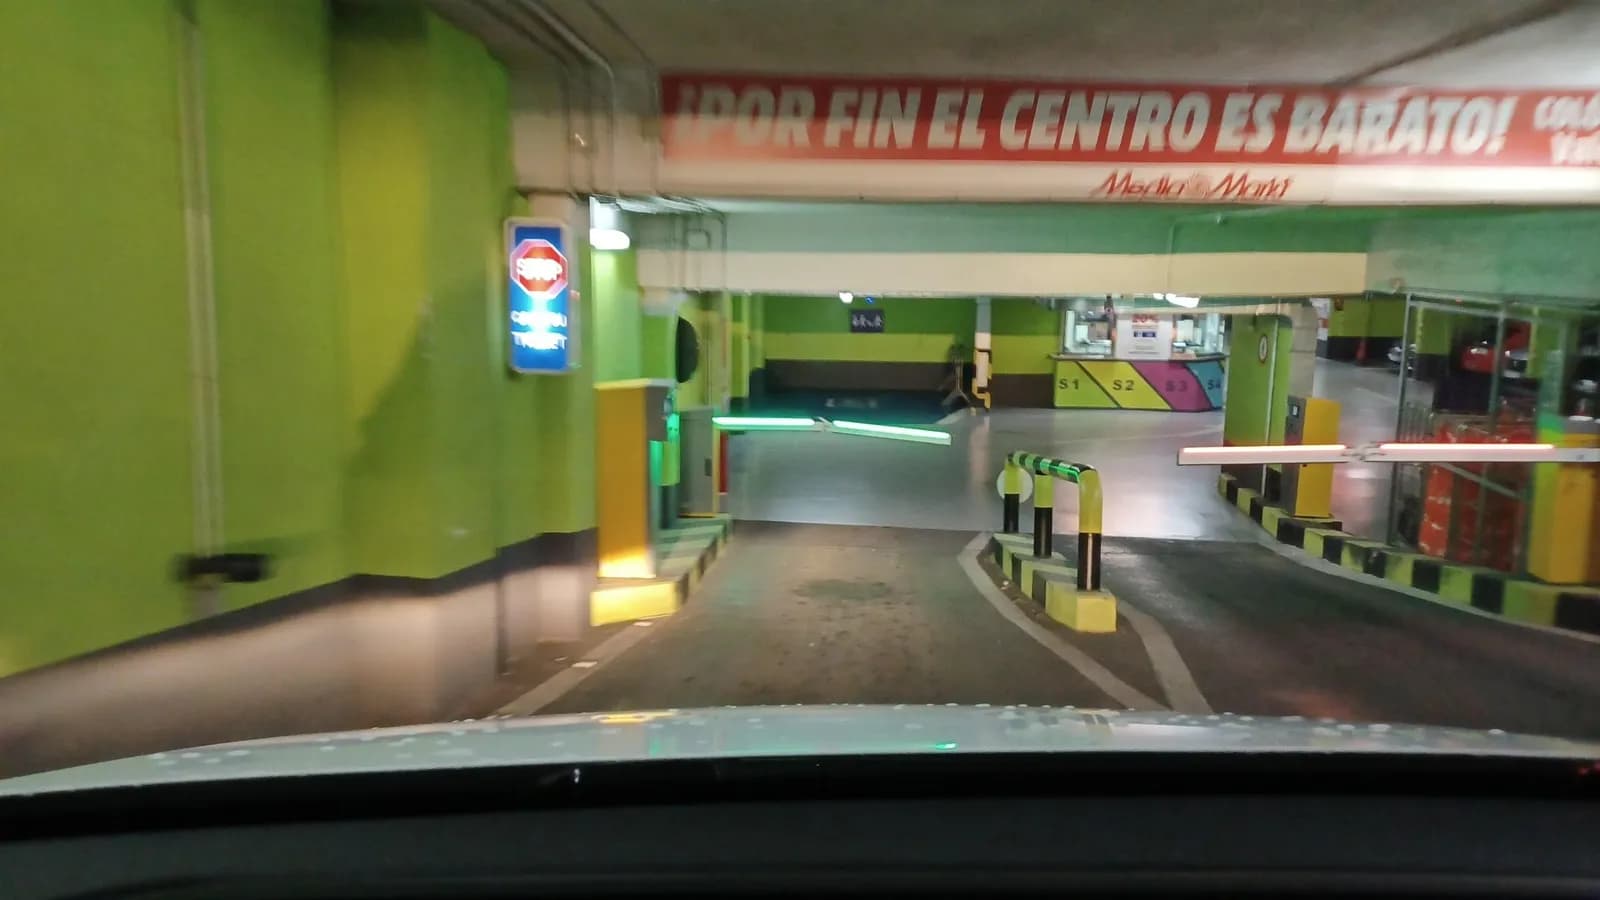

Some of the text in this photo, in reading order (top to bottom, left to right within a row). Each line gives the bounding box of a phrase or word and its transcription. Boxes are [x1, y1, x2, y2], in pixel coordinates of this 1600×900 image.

[823, 87, 922, 149] FIN
[927, 87, 987, 150] EL
[999, 89, 1211, 152] CENTRO
[1214, 92, 1278, 153] ES
[1283, 94, 1519, 155] BARATO!
